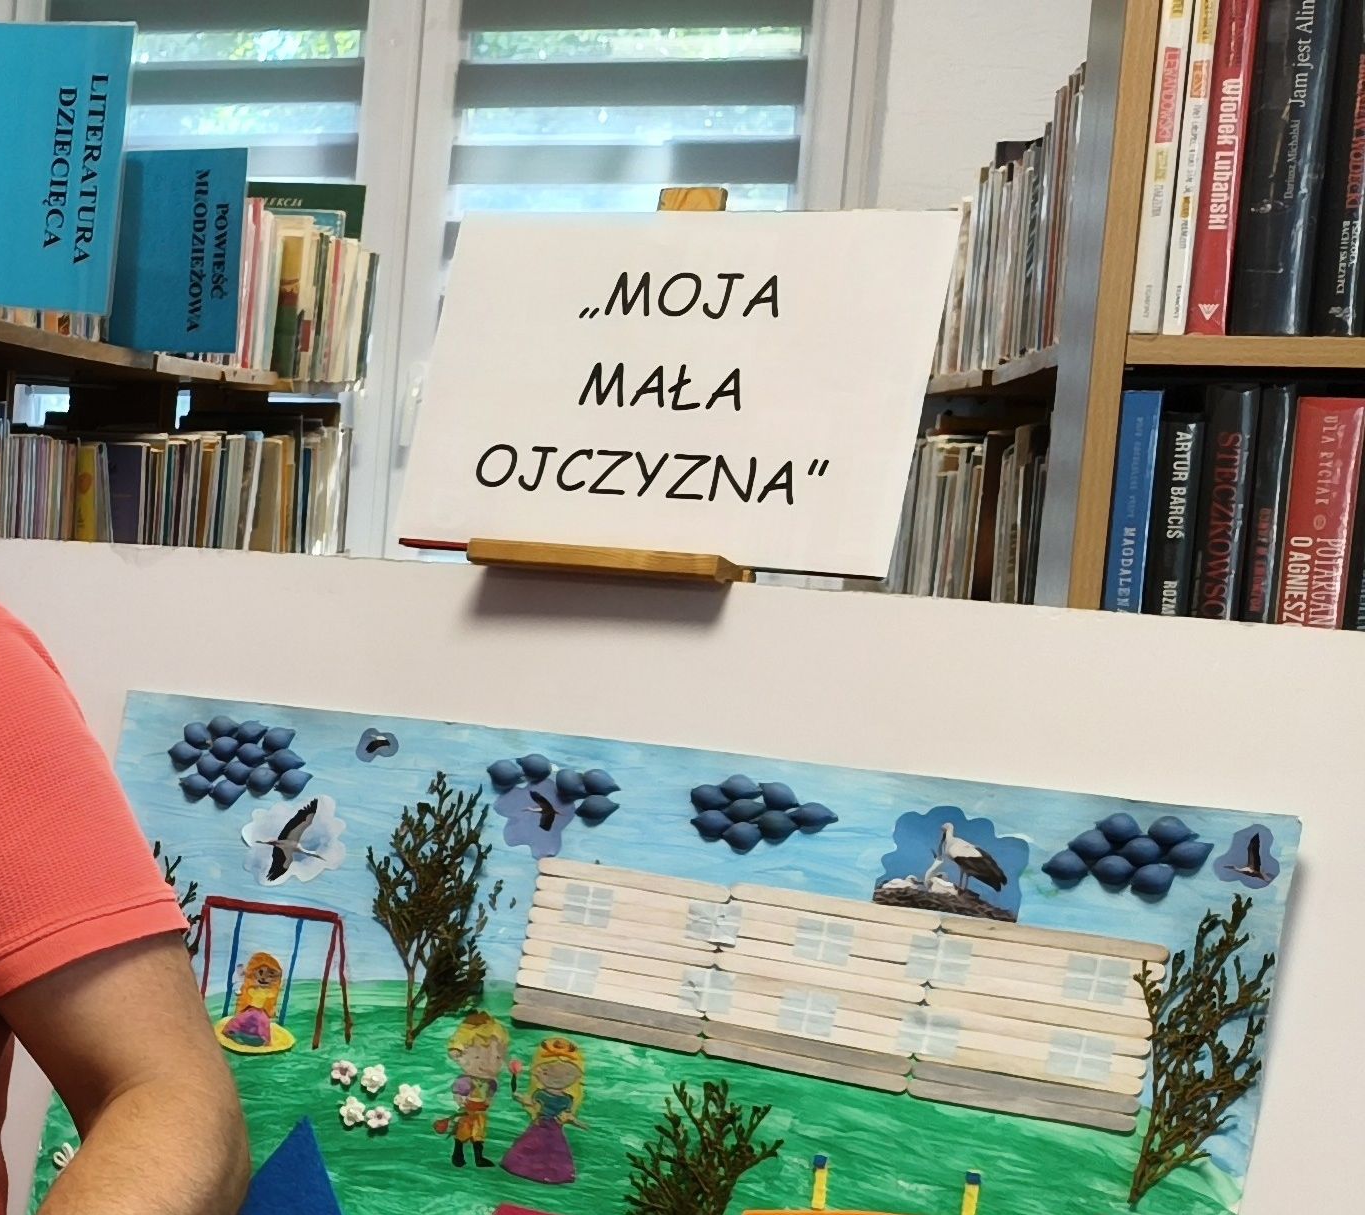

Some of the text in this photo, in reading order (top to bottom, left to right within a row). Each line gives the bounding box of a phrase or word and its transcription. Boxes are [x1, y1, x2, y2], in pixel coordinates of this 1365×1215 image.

[1156, 47, 1181, 143] LEWANDOWSKI
[1290, 72, 1310, 108] Jam
[1295, 37, 1314, 70] jest
[42, 87, 77, 248] DZIECIĘCA
[73, 74, 109, 264] LITERATURA
[1209, 78, 1243, 230] Włodek Lubański
[1284, 119, 1300, 200] Dariusz Michalski
[186, 169, 211, 332] MŁODZIEŻOWA
[210, 203, 230, 300] POWIEŚĆ
[578, 272, 780, 320] „MOJA
[578, 365, 742, 412] MAŁA
[1166, 431, 1191, 540] ARTUR BARCIŚ
[1315, 415, 1339, 505] ULA RYCIAK
[1290, 536, 1312, 548] O
